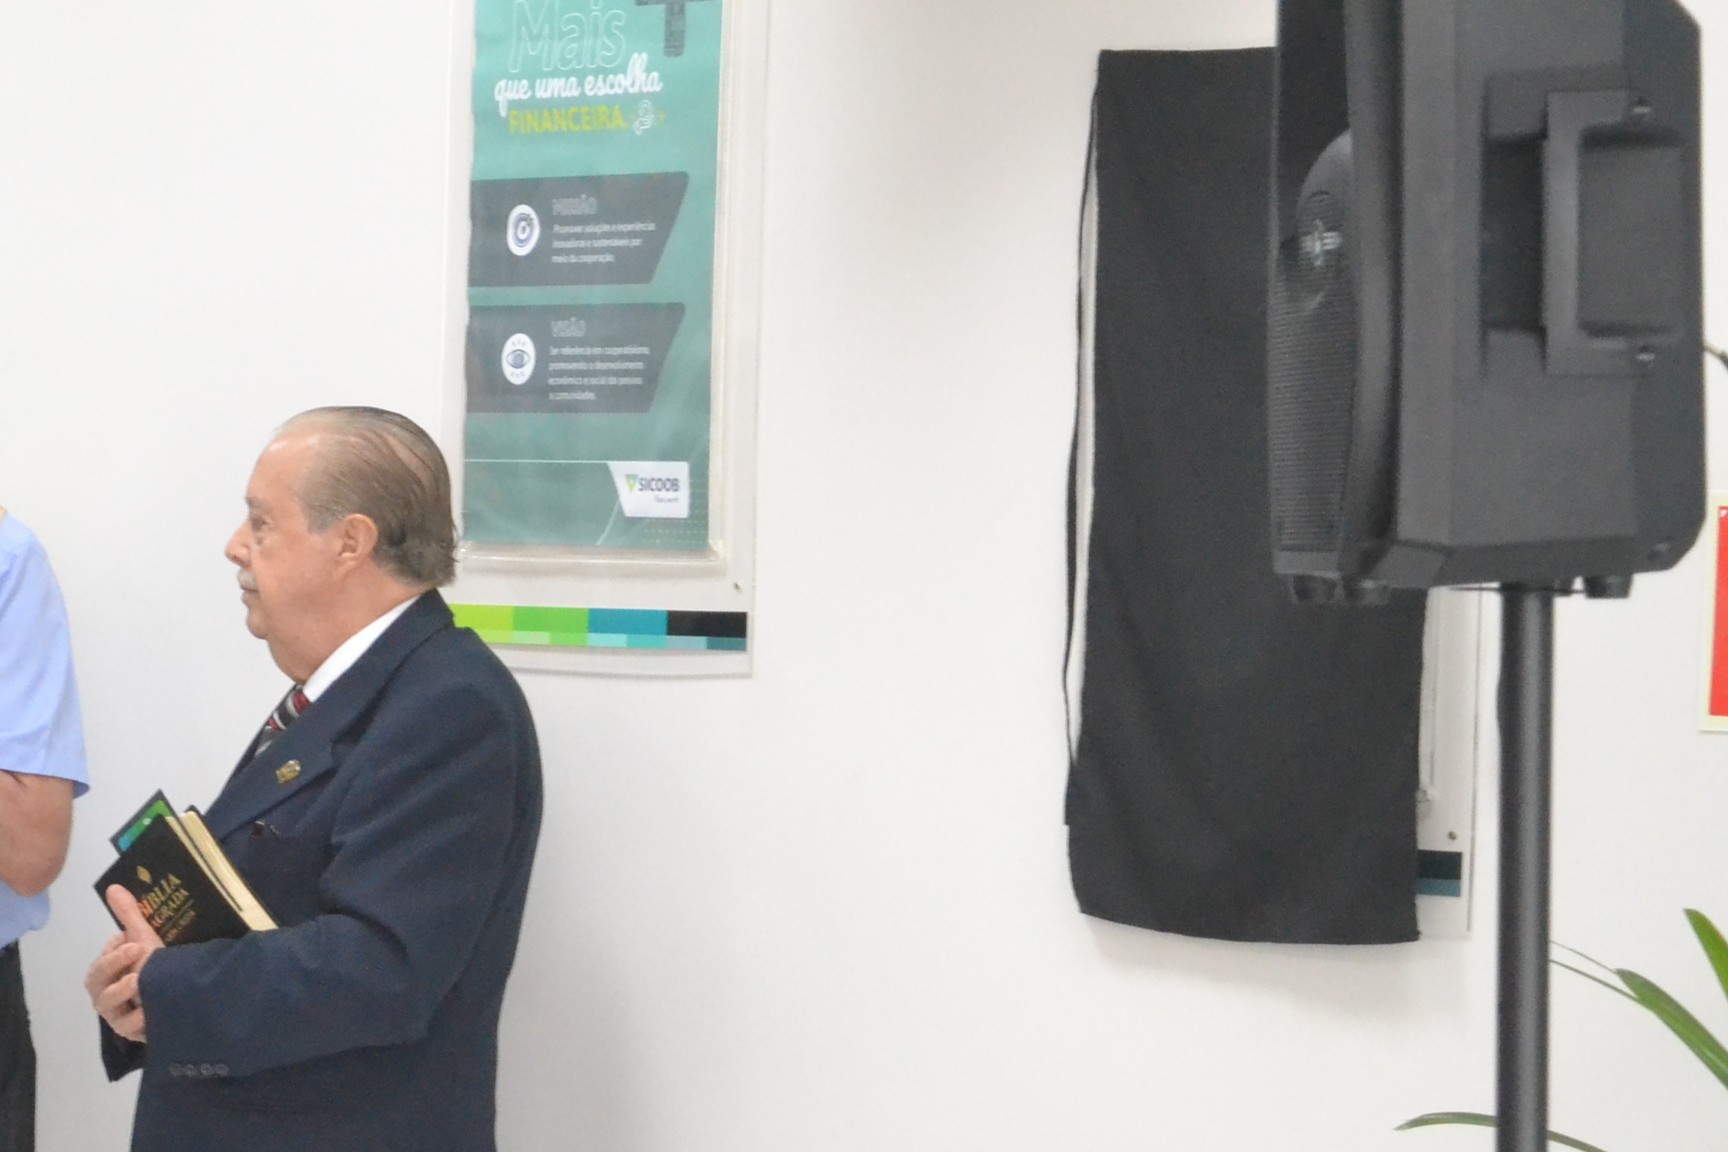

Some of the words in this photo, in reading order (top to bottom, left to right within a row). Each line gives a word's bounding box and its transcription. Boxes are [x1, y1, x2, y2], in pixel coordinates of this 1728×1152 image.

[508, 0, 627, 72] Mais
[494, 79, 532, 117] que
[534, 76, 582, 98] uma
[584, 52, 664, 96] escolha
[638, 477, 681, 493] SICOOB
